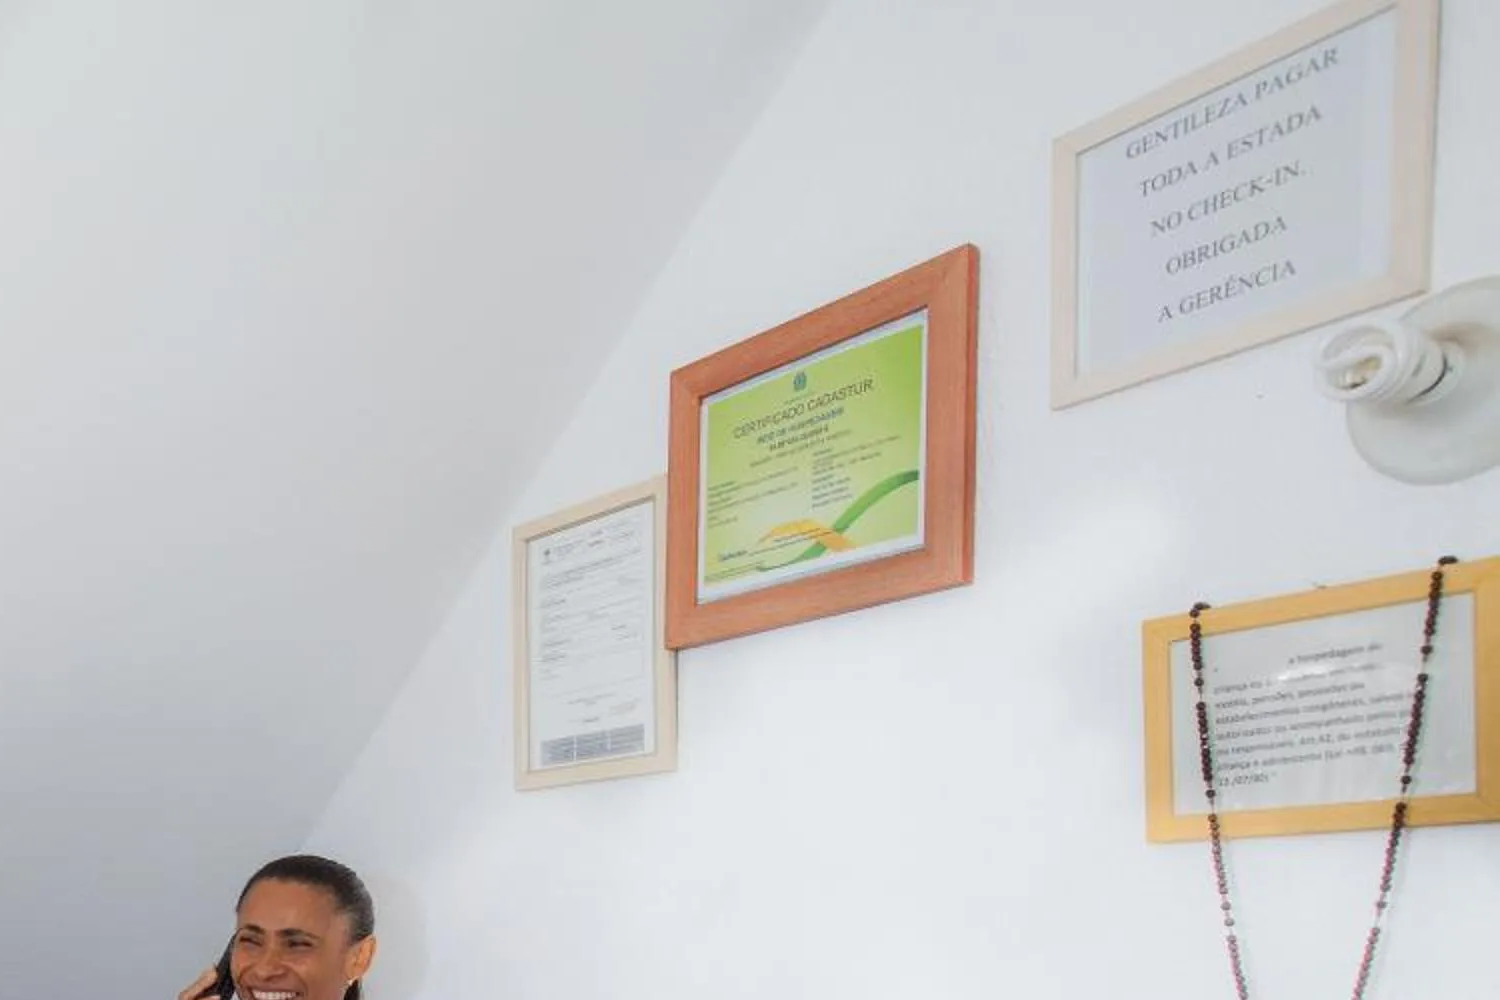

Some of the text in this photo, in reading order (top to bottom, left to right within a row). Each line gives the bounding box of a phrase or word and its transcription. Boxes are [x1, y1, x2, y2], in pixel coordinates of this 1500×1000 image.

[1125, 47, 1339, 160] GENTILEZA PAGAR
[1139, 104, 1323, 198] TODA A ESTADA
[1150, 161, 1306, 238] NO CHECK-IN.
[1165, 216, 1289, 275] OBRIGADA
[1157, 259, 1297, 323] A GERÊNCIA
[733, 404, 805, 439] CERTIFICADO
[807, 378, 874, 411] CADASTUR
